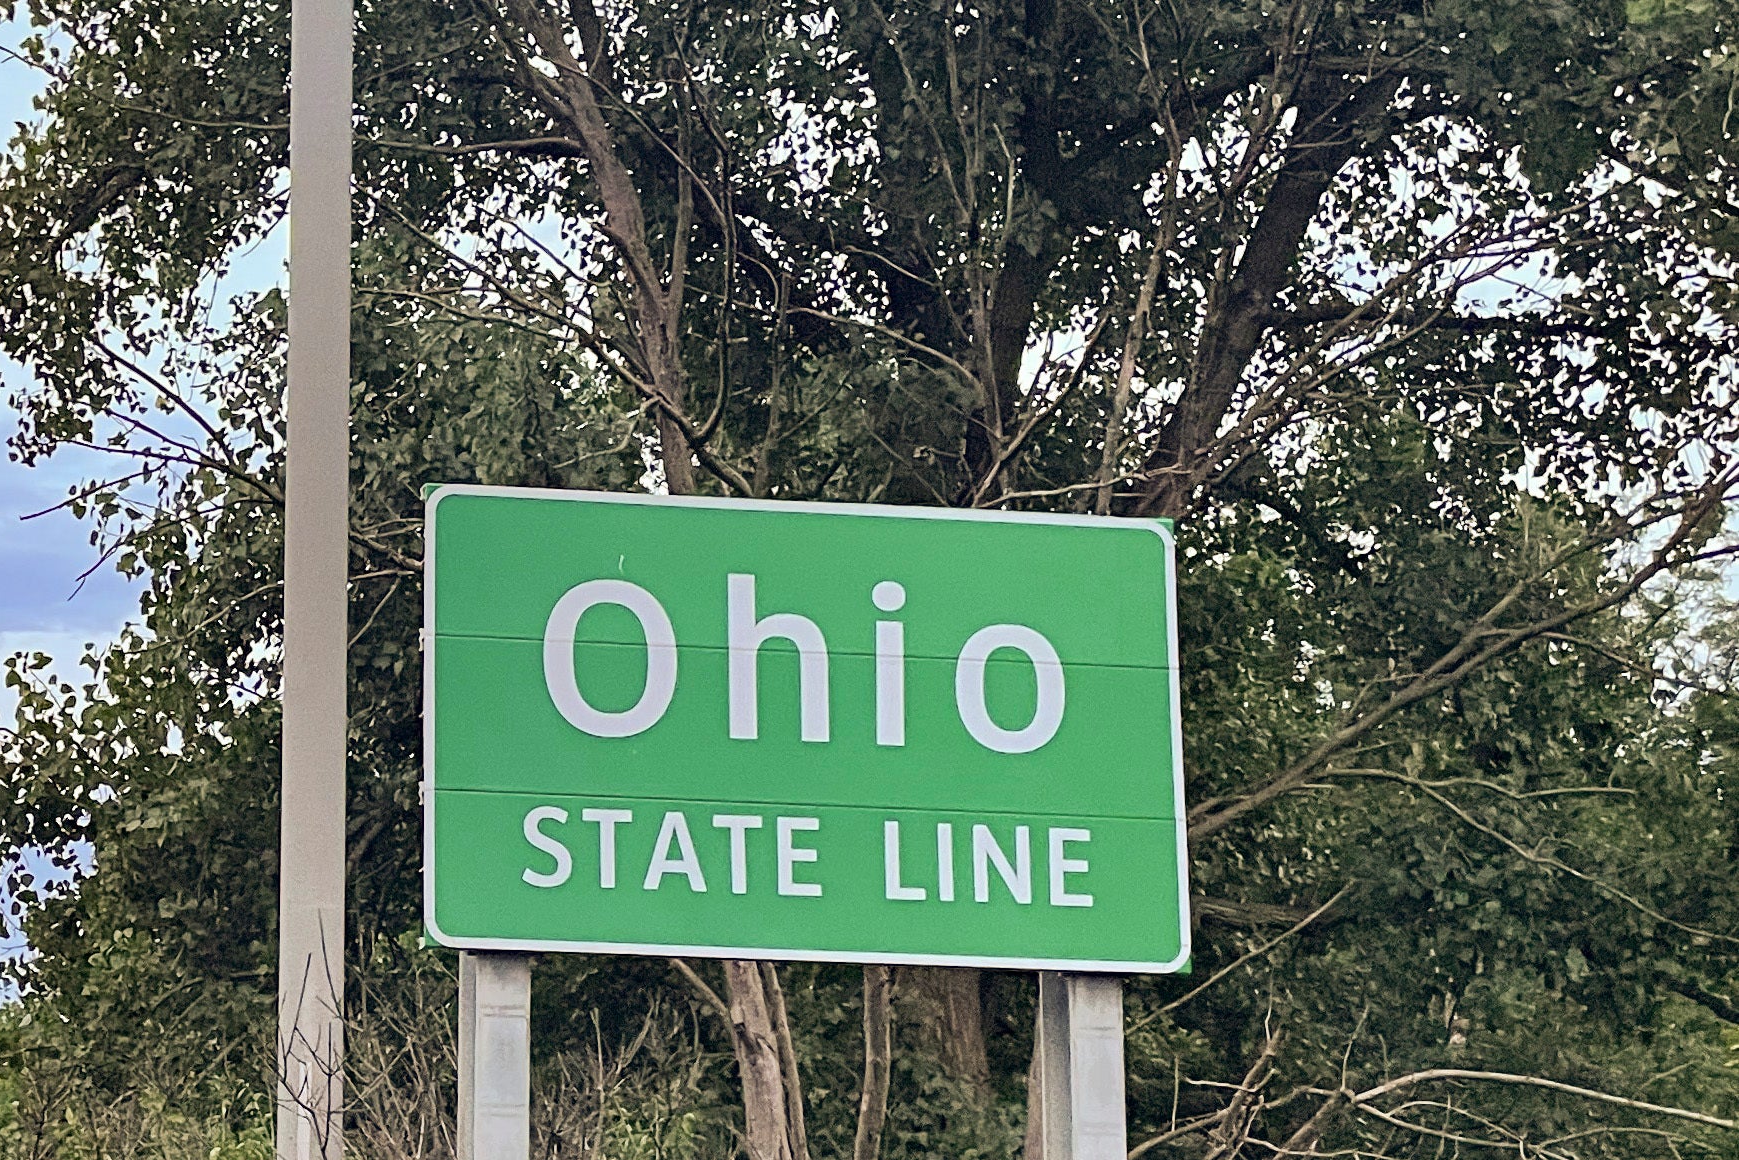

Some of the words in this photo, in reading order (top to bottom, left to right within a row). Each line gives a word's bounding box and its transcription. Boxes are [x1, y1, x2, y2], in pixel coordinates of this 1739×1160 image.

[543, 573, 1066, 754] Ohio
[521, 805, 823, 897] STATE
[884, 820, 1094, 908] LINE
